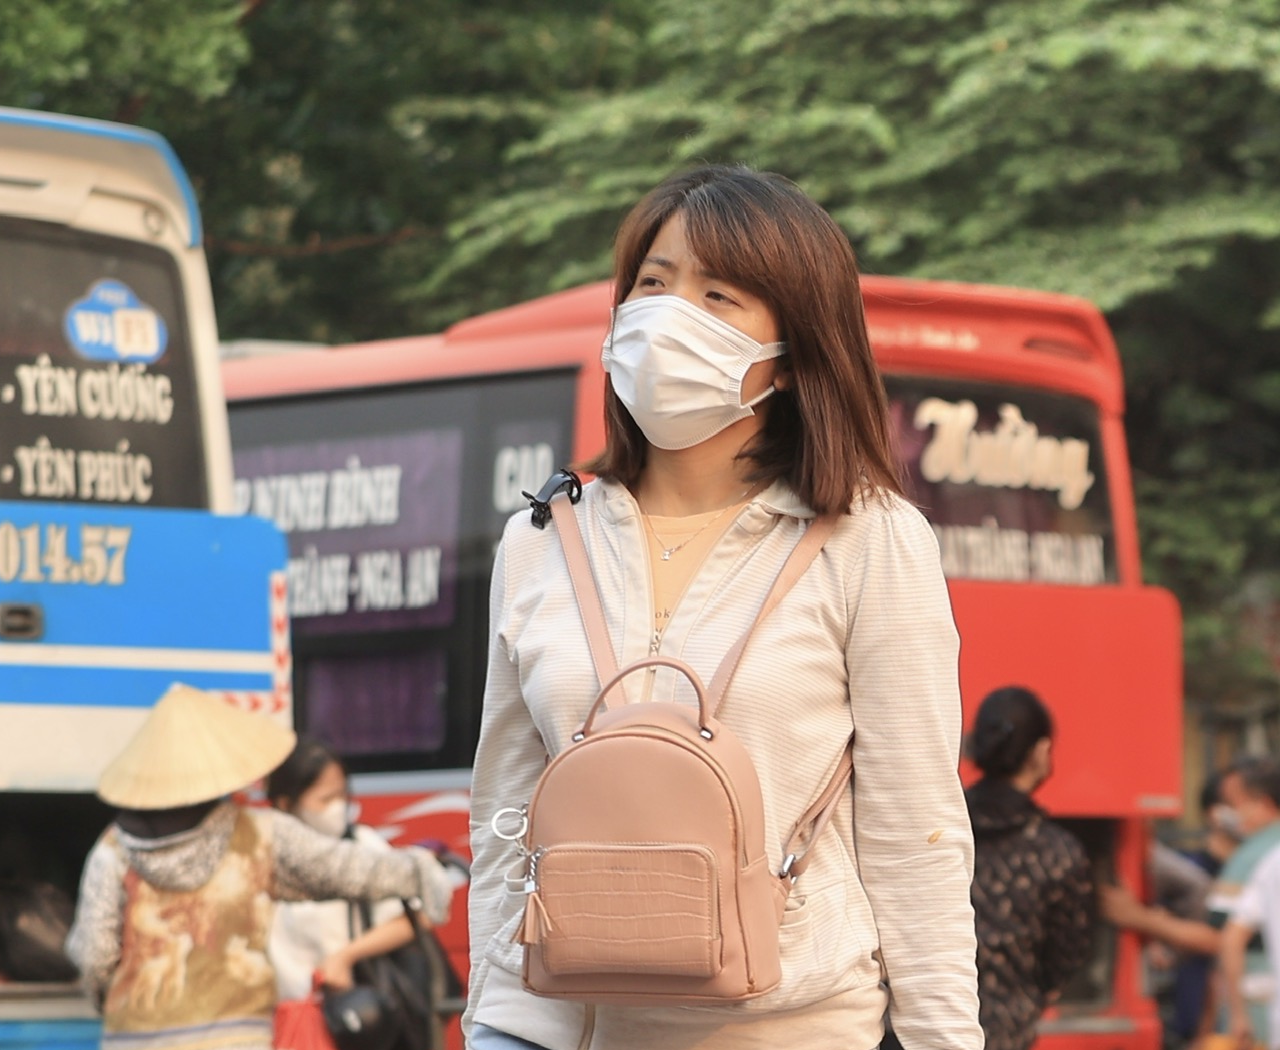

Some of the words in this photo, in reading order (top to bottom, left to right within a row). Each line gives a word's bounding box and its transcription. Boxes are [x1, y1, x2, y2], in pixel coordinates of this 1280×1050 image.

[16, 352, 77, 416] YÊN
[14, 435, 76, 497] YÊN
[77, 438, 153, 503] PHÚC
[328, 454, 402, 530] BÌNH
